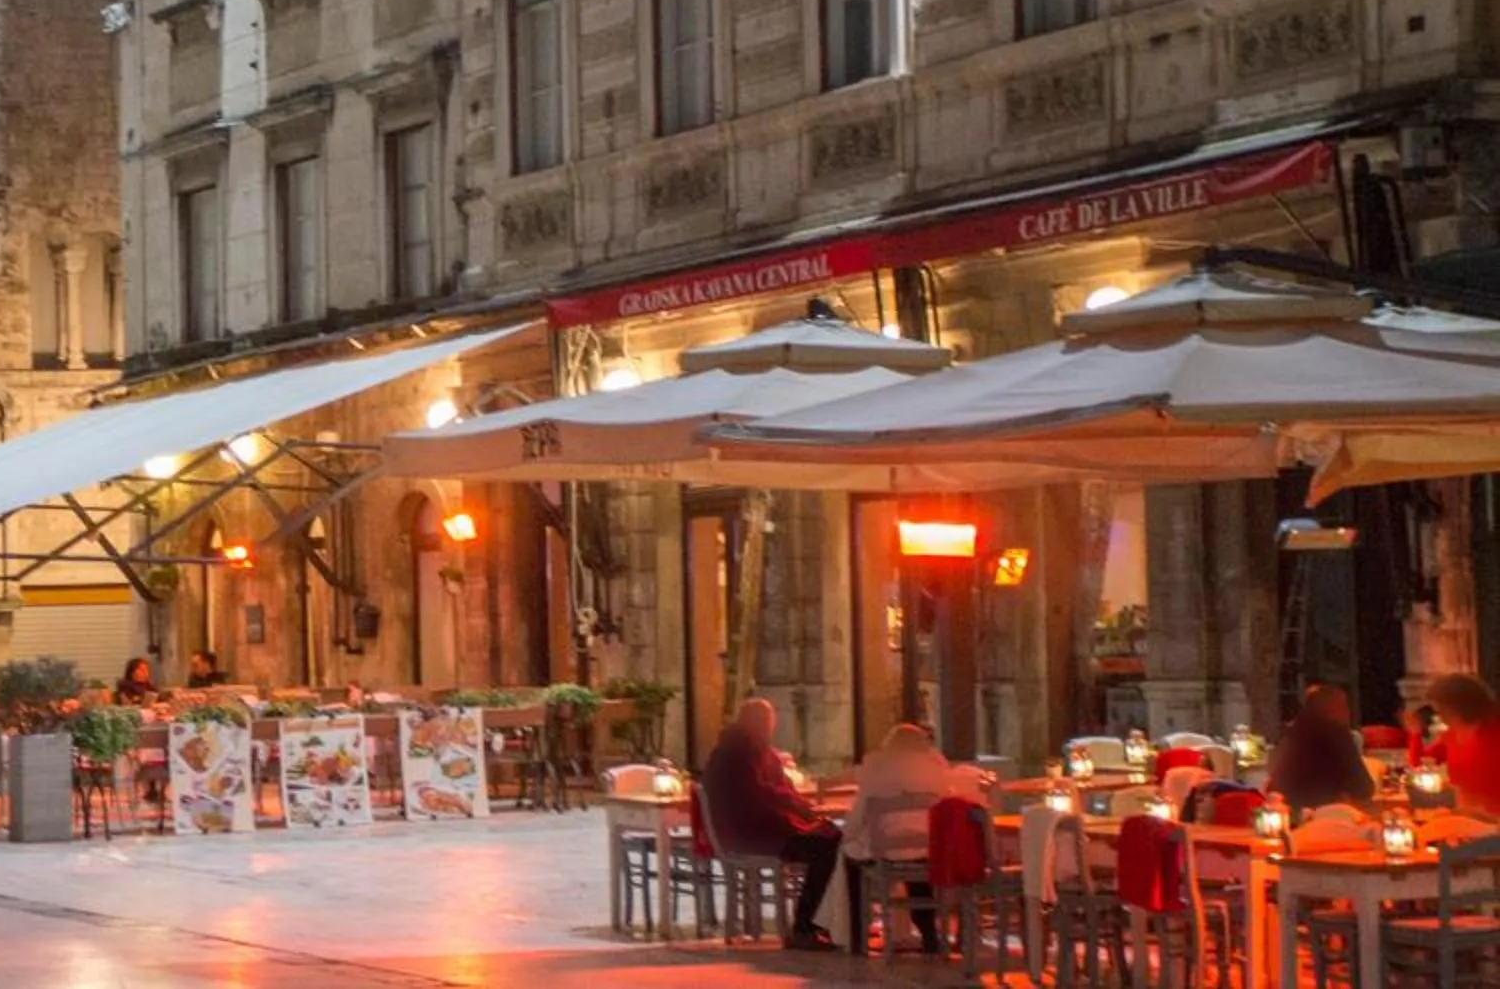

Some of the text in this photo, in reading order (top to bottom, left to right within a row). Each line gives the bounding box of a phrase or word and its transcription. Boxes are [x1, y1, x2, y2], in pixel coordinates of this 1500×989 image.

[1077, 200, 1107, 229] DE
[1110, 195, 1140, 222] LA
[1141, 179, 1209, 214] VILLE
[618, 253, 833, 316] GRADSKA KAVANA CENTRAL
